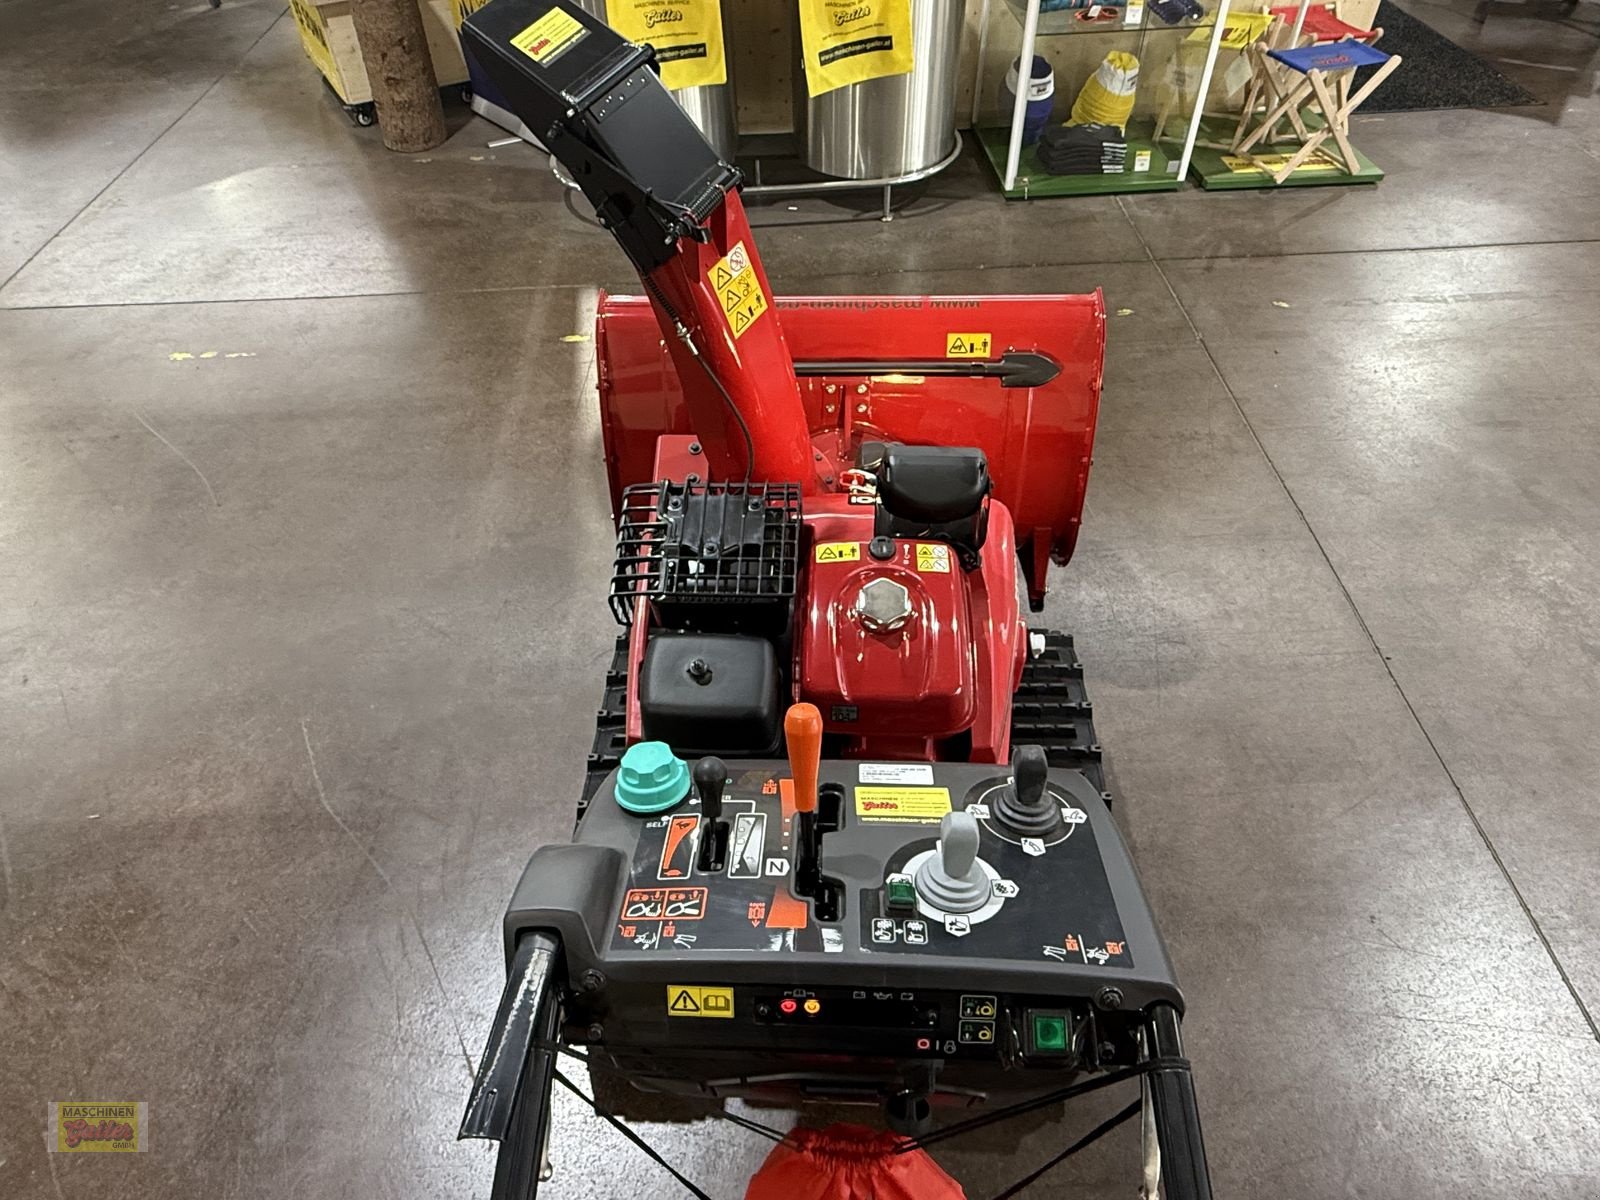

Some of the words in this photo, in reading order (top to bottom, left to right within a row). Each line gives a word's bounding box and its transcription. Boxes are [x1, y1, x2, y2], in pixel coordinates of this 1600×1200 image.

[643, 9, 683, 29] Gailer
[832, 6, 871, 26] Gailer
[769, 861, 785, 872] N
